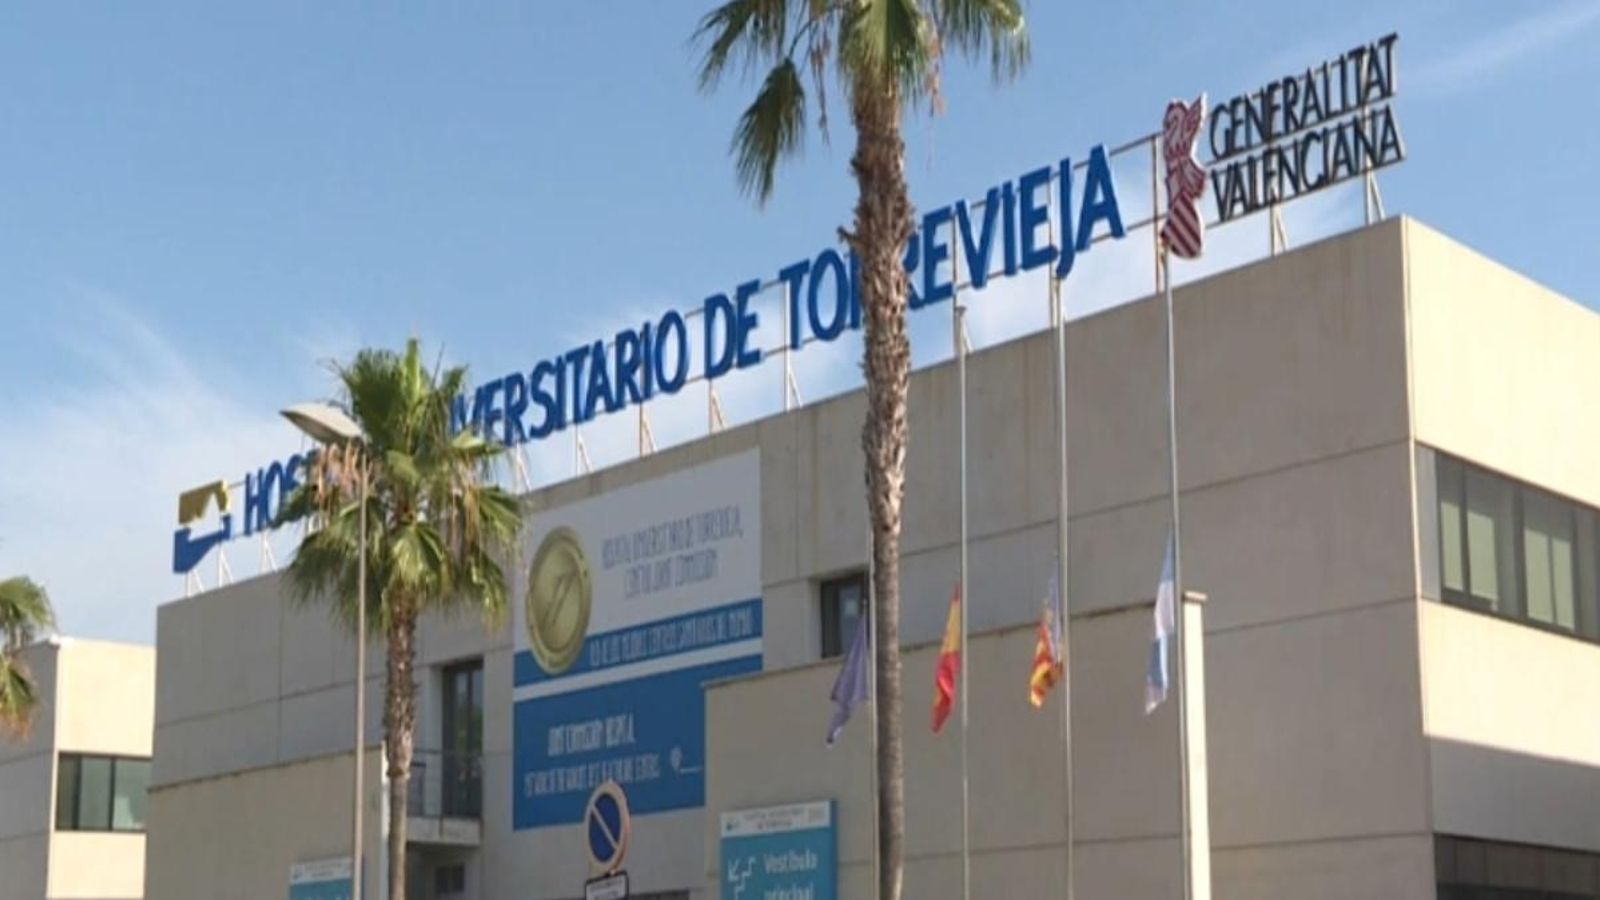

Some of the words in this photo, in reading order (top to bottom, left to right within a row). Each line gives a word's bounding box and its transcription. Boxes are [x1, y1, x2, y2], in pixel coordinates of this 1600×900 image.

[1209, 32, 1398, 161] GENERALITAT
[1210, 103, 1405, 222] VALENCIANA
[703, 279, 761, 379] DE
